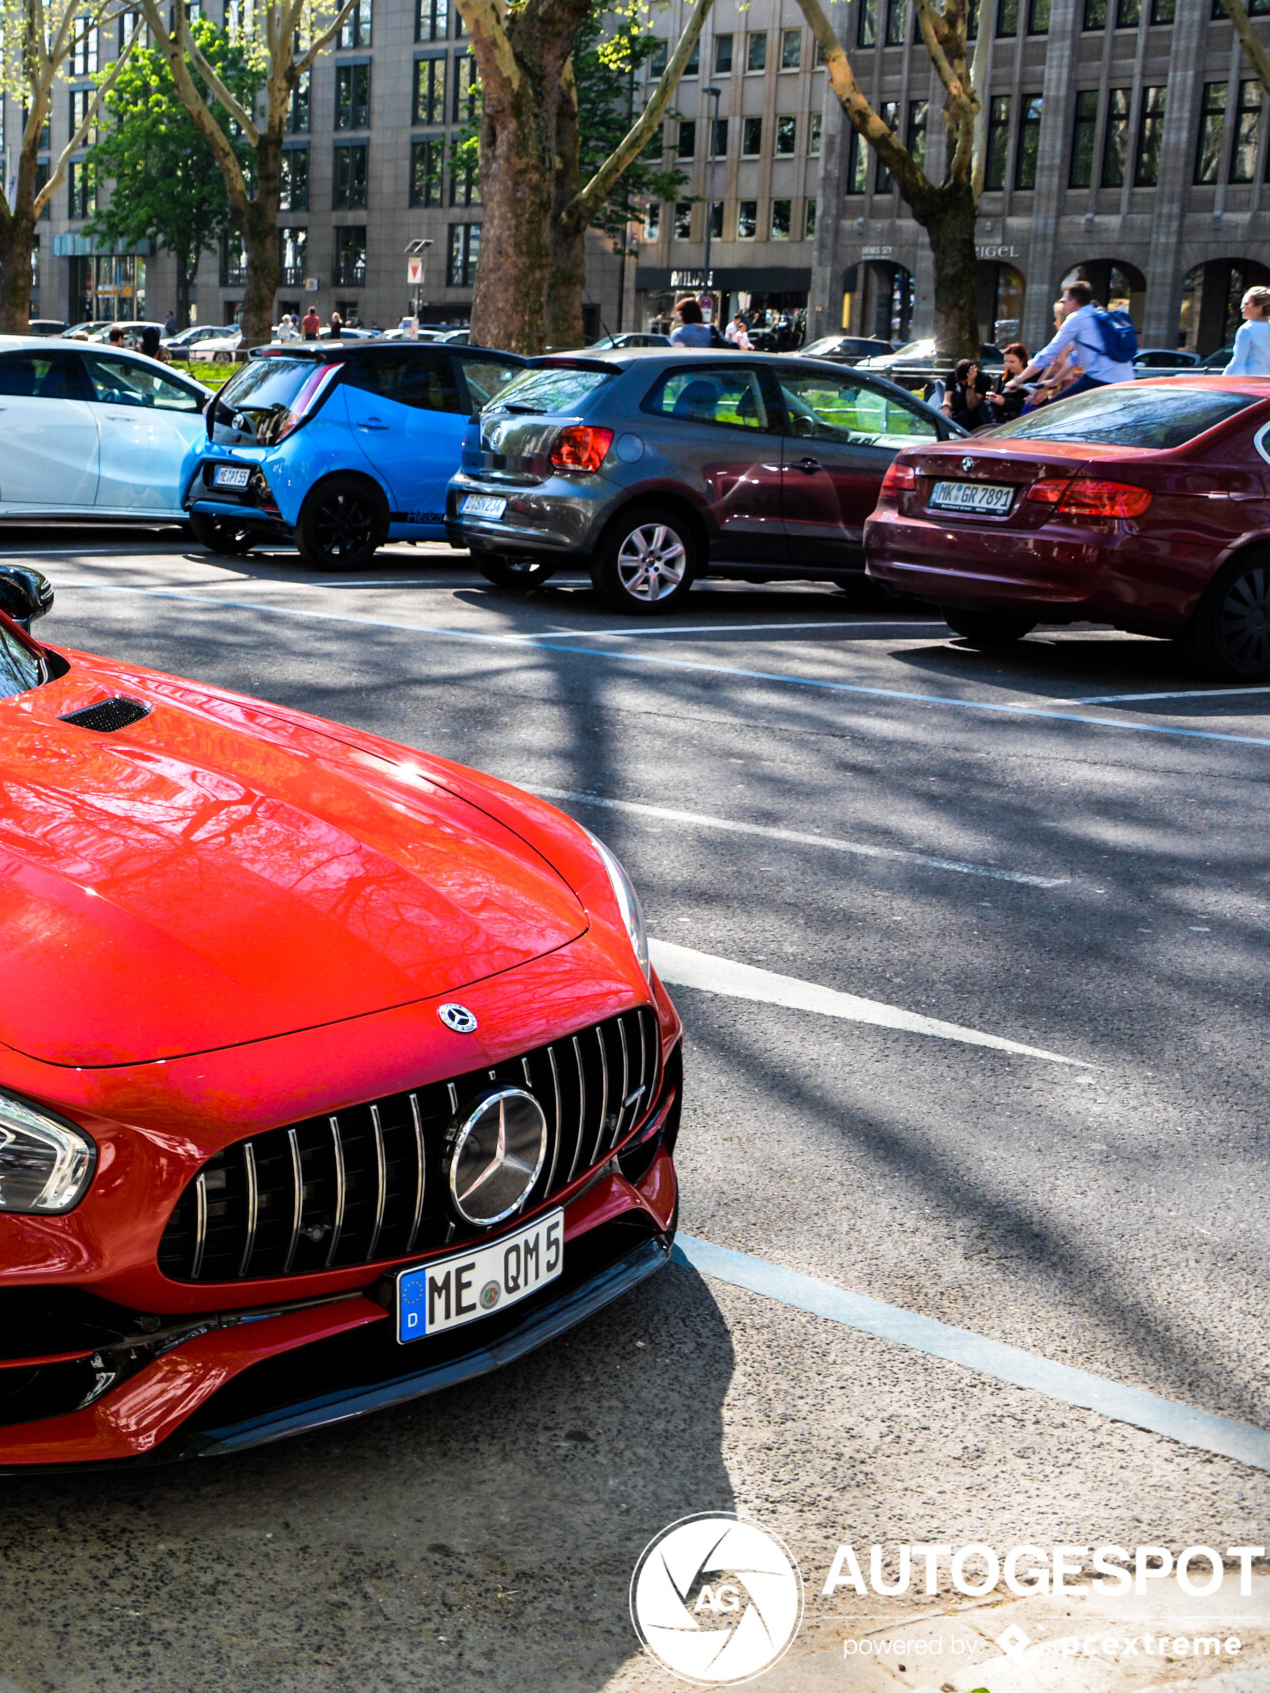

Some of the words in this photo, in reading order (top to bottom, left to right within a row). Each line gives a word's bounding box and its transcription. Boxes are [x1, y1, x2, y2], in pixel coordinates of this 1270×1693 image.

[938, 483, 955, 502] MK
[961, 486, 979, 504] GR
[979, 488, 1011, 507] 7891
[429, 1262, 476, 1325] ME
[504, 1232, 540, 1295] QM
[546, 1220, 560, 1273] 5
[407, 1312, 418, 1328] D
